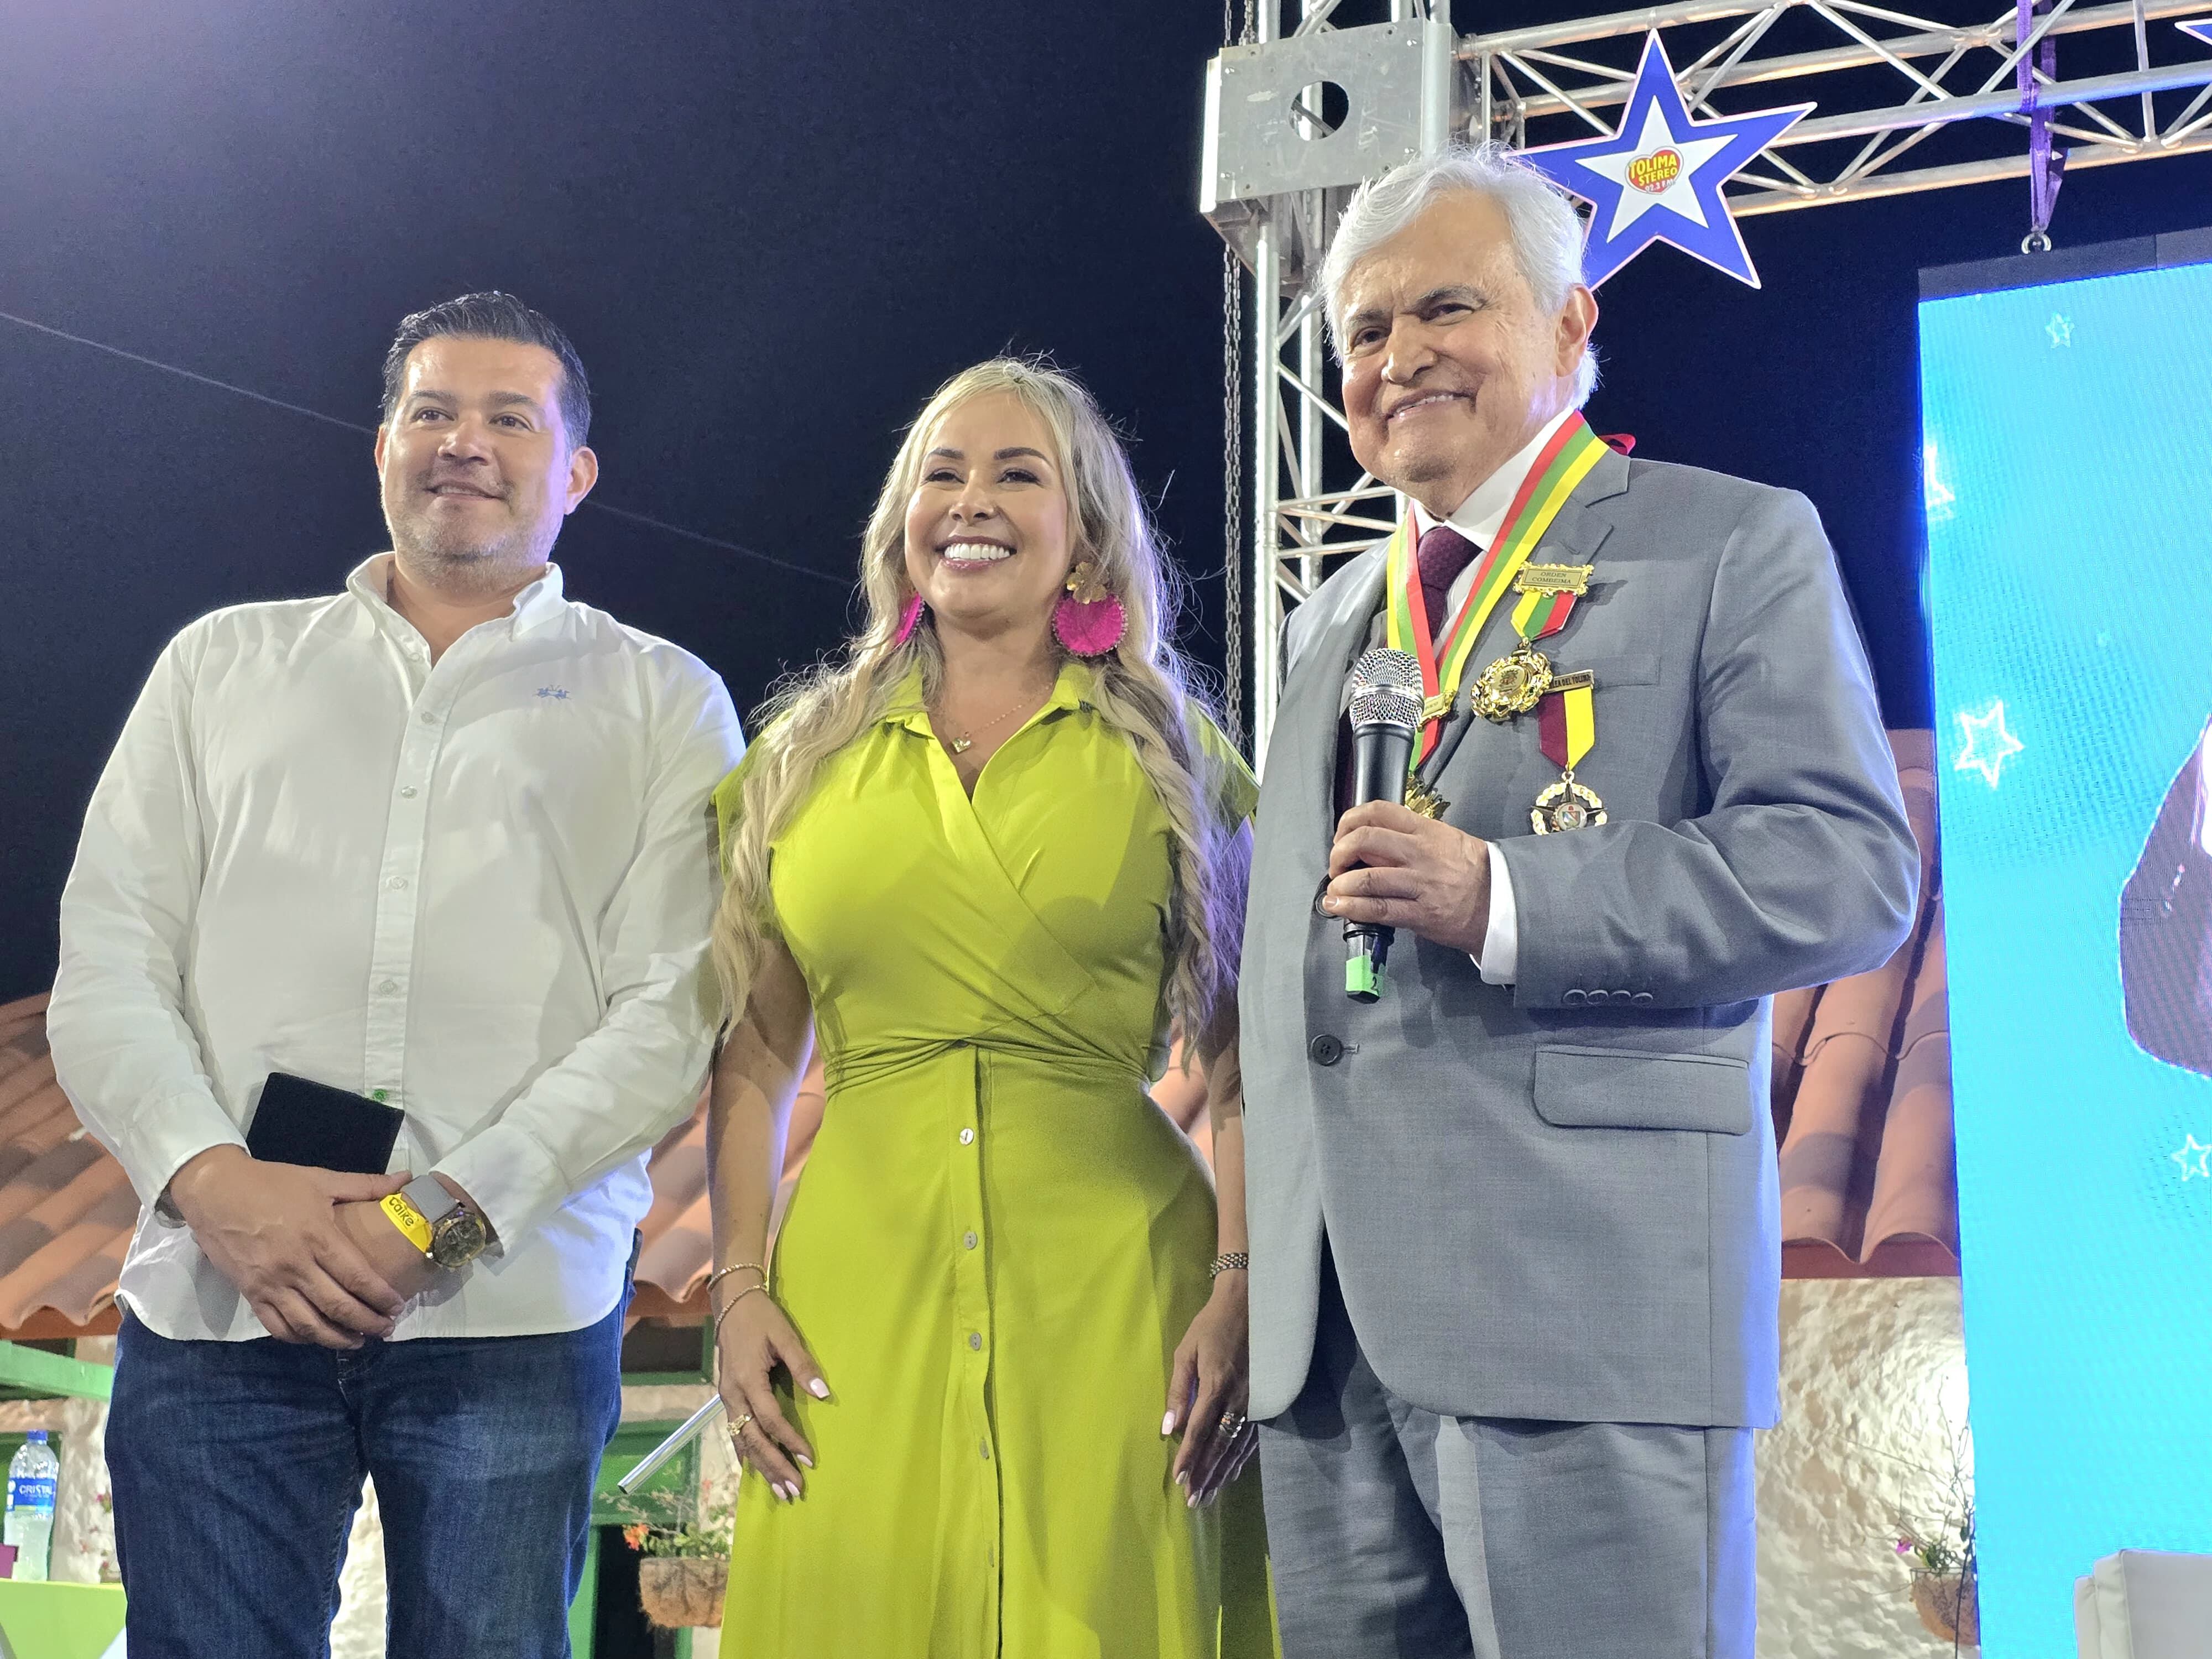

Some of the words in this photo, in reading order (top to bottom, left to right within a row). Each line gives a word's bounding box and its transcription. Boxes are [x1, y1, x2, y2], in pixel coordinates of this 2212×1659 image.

[1629, 154, 1677, 179] TOLIMA
[1639, 167, 1678, 186] STEREO
[1645, 181, 1660, 192] 92.3
